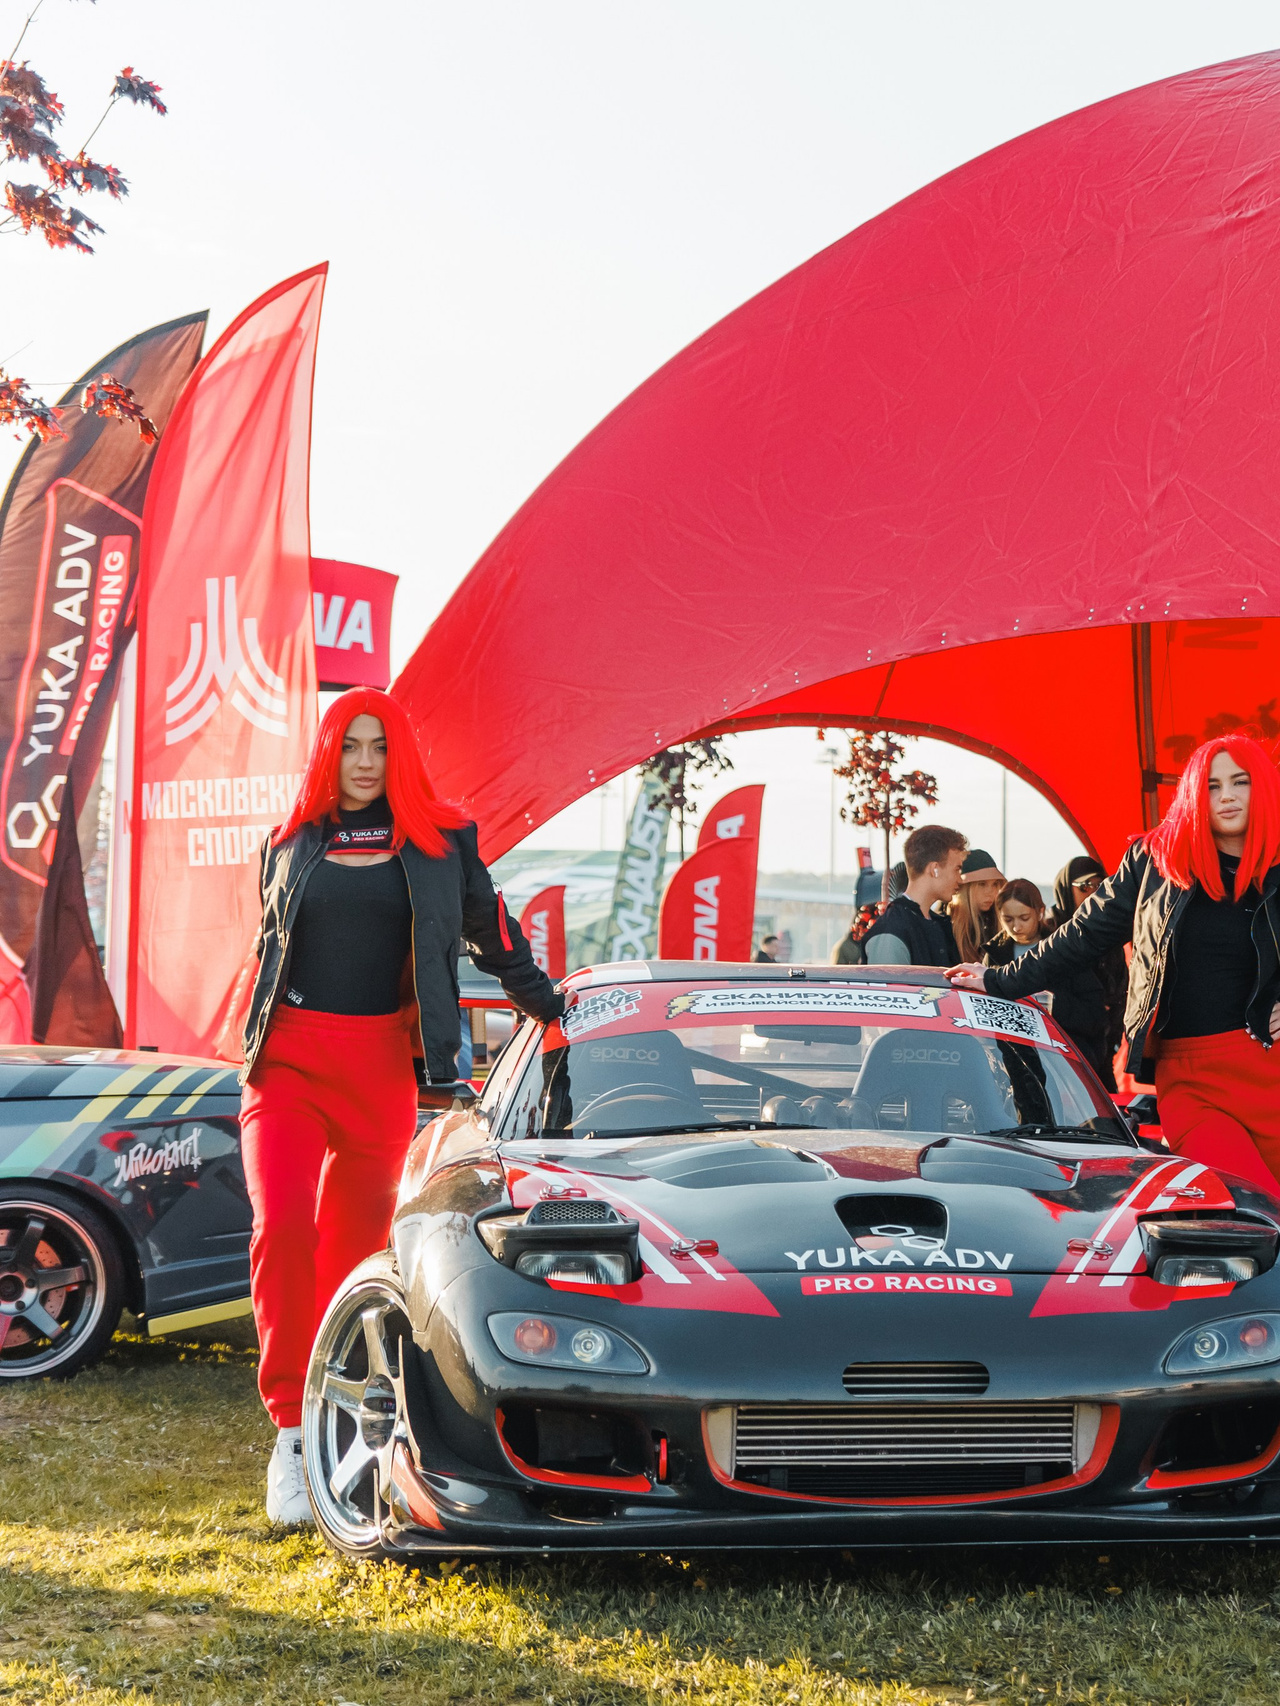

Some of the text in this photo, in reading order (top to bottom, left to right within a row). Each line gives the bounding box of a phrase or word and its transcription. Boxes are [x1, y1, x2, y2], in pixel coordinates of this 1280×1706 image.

[90, 550, 125, 672] RACING
[22, 523, 97, 767] YUKA ADV
[712, 992, 910, 1004] СКАНИРУЙ КОД
[562, 990, 642, 1028] DRIVE
[590, 1047, 660, 1063] sparco
[891, 1048, 962, 1064] sparco
[784, 1247, 1014, 1271] YUKA ADV
[815, 1276, 998, 1293] PRO RACING
